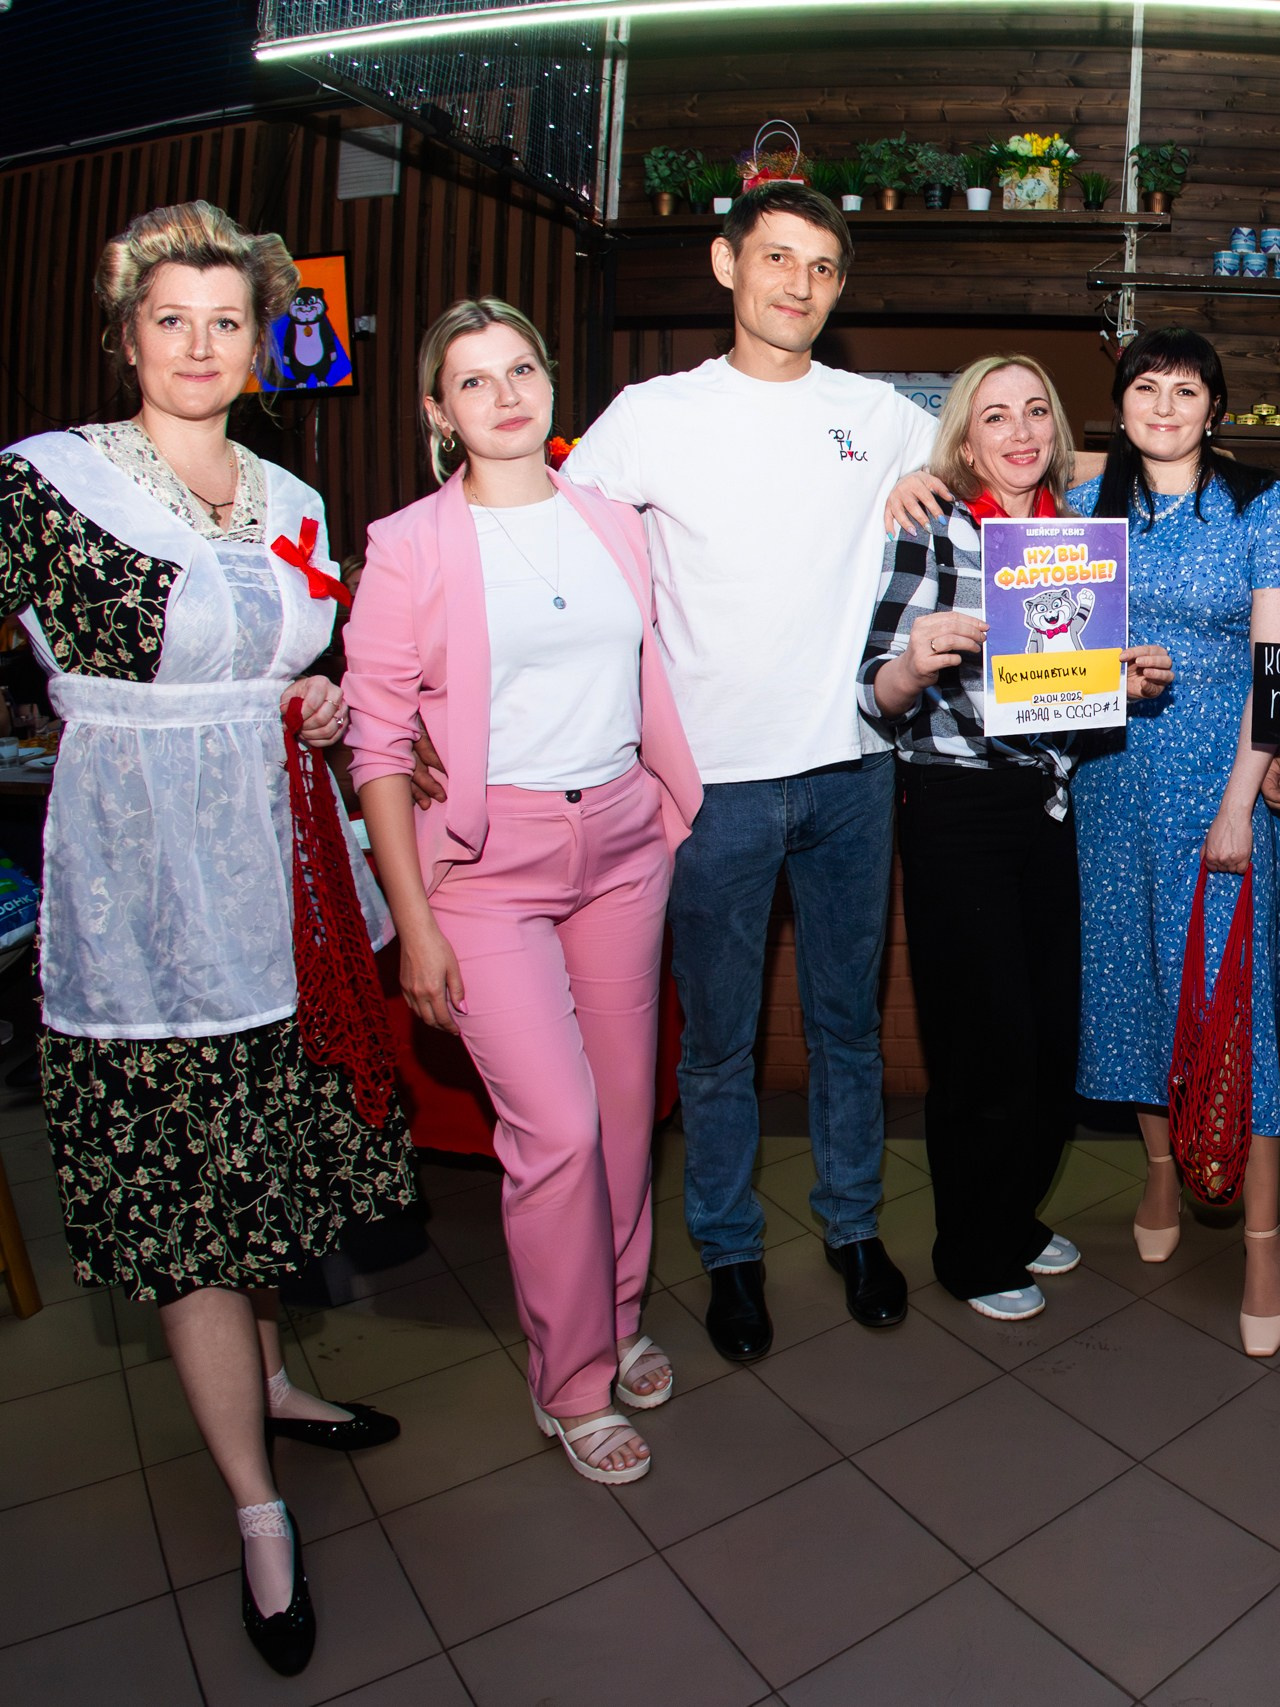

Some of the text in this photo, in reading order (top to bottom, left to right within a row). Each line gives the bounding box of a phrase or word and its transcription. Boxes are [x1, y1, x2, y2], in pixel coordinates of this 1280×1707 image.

[1026, 527, 1085, 536] ШЕЙКЕР КВИЗ
[1025, 545, 1087, 565] НУ ВЫ
[996, 561, 1115, 588] ФАРТОВЫЕ!
[1016, 707, 1050, 724] НАЗАД
